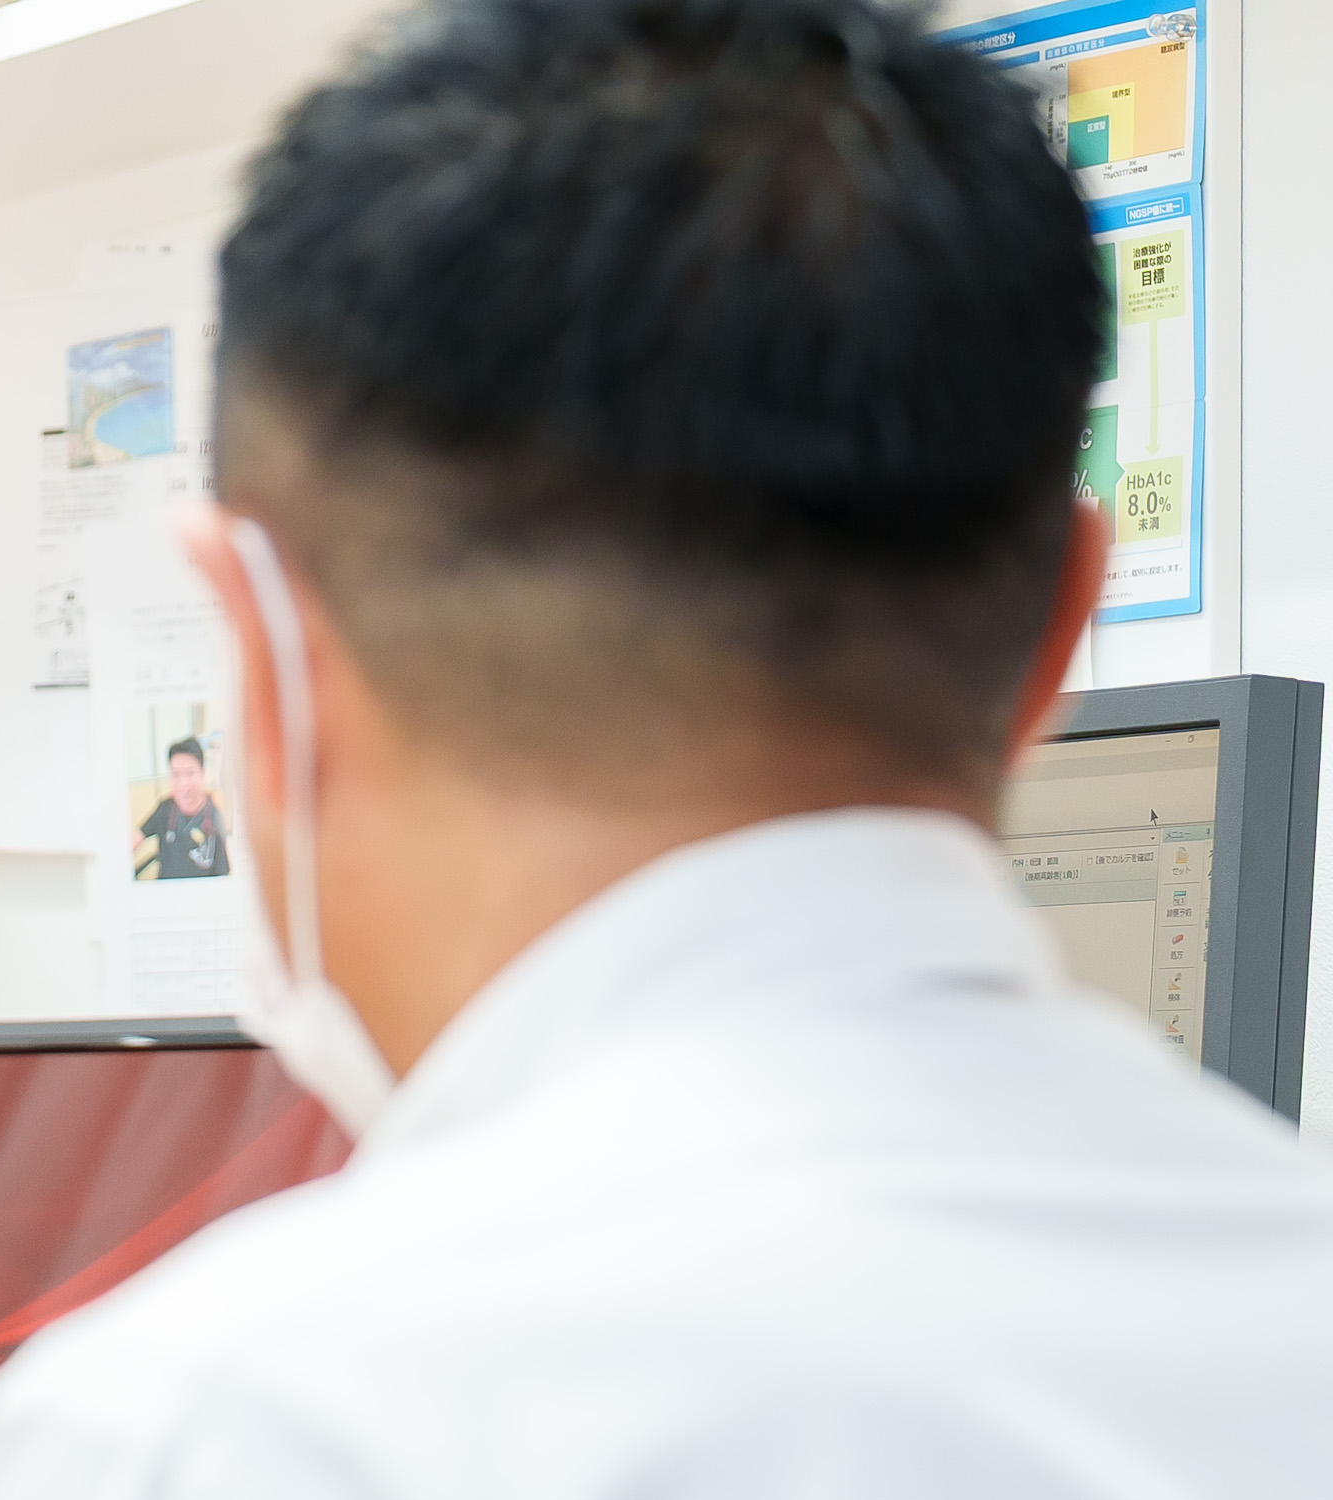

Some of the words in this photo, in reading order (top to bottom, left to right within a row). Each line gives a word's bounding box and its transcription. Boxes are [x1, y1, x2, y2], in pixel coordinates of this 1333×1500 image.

[1133, 241, 1172, 258] 治療強化が
[1142, 267, 1165, 287] 目標
[1126, 471, 1172, 490] HbA1c
[1127, 491, 1172, 516] 8.0%
[1138, 516, 1160, 531] 未満
[1165, 831, 1191, 839] メニュー
[1172, 866, 1191, 875] セット
